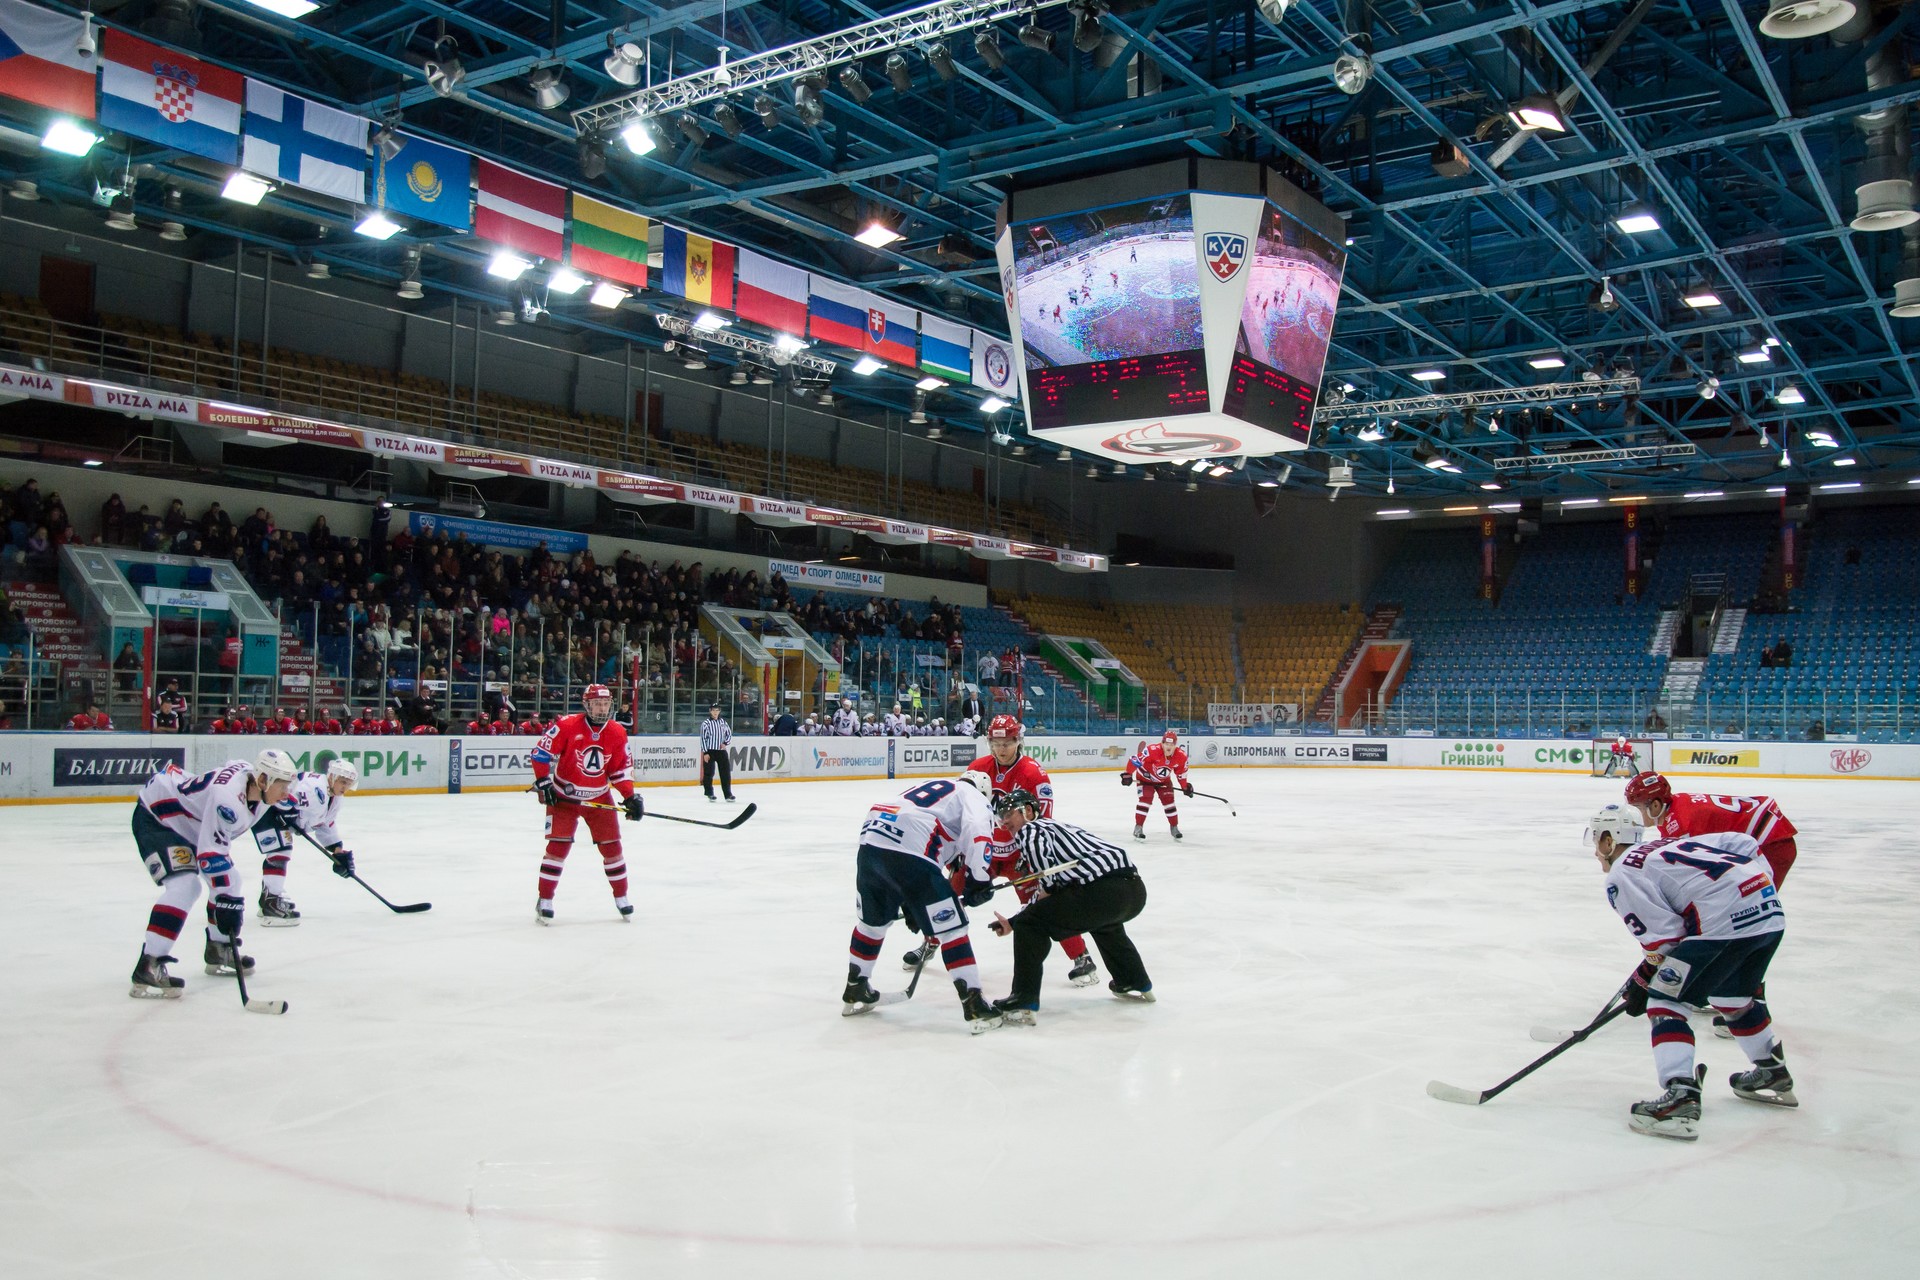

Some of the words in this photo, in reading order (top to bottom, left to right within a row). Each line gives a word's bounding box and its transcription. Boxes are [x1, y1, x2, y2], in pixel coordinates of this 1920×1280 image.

[20, 375, 53, 391] MIA
[107, 392, 152, 408] PIZZA
[158, 400, 188, 414] MIA
[210, 413, 260, 425] БОЛЕЕШЬ
[262, 418, 274, 426] ЗА
[375, 437, 410, 452] PIZZA
[414, 443, 438, 456] MIA
[540, 464, 568, 478] PIZZA
[572, 470, 592, 481] MIA
[692, 490, 716, 502] PIZZA
[719, 494, 735, 504] MIA
[760, 502, 783, 513] PIZZA
[786, 506, 802, 516] MIA
[892, 524, 910, 535] PIZZA
[912, 527, 924, 536] MIA
[978, 538, 995, 550] PIZZA
[771, 562, 799, 576] ОЛМЕД
[808, 568, 832, 580] СПОРТ
[835, 571, 861, 582] ОЛМЕД
[868, 576, 882, 584] ВАС
[642, 746, 686, 754] ПРАВИТЕЛЬСТВО
[904, 750, 949, 762] СОГАЗ
[1024, 746, 1058, 763] ТРИ+
[1066, 748, 1098, 756] CHEVROLET
[1224, 746, 1286, 758] ГАЗПРОМБАНК
[1294, 746, 1350, 758] СОГАЗ
[1441, 750, 1504, 766] ГРИНВИЧ
[1535, 748, 1642, 764] СМОТР+
[286, 749, 427, 778] МОТРИ+
[465, 754, 533, 770] СОГАЗ
[634, 756, 672, 770] ВЕРДЛОВСКОЙ
[673, 757, 697, 769] ОБЛАСТИ
[823, 756, 886, 768] АГРОПРОМКРЕДИТ
[1690, 752, 1738, 765] Nikon
[1836, 750, 1866, 770] KitKat
[69, 758, 174, 776] БАЛТИКА
[450, 753, 459, 785] pepsi
[904, 780, 956, 808] 8
